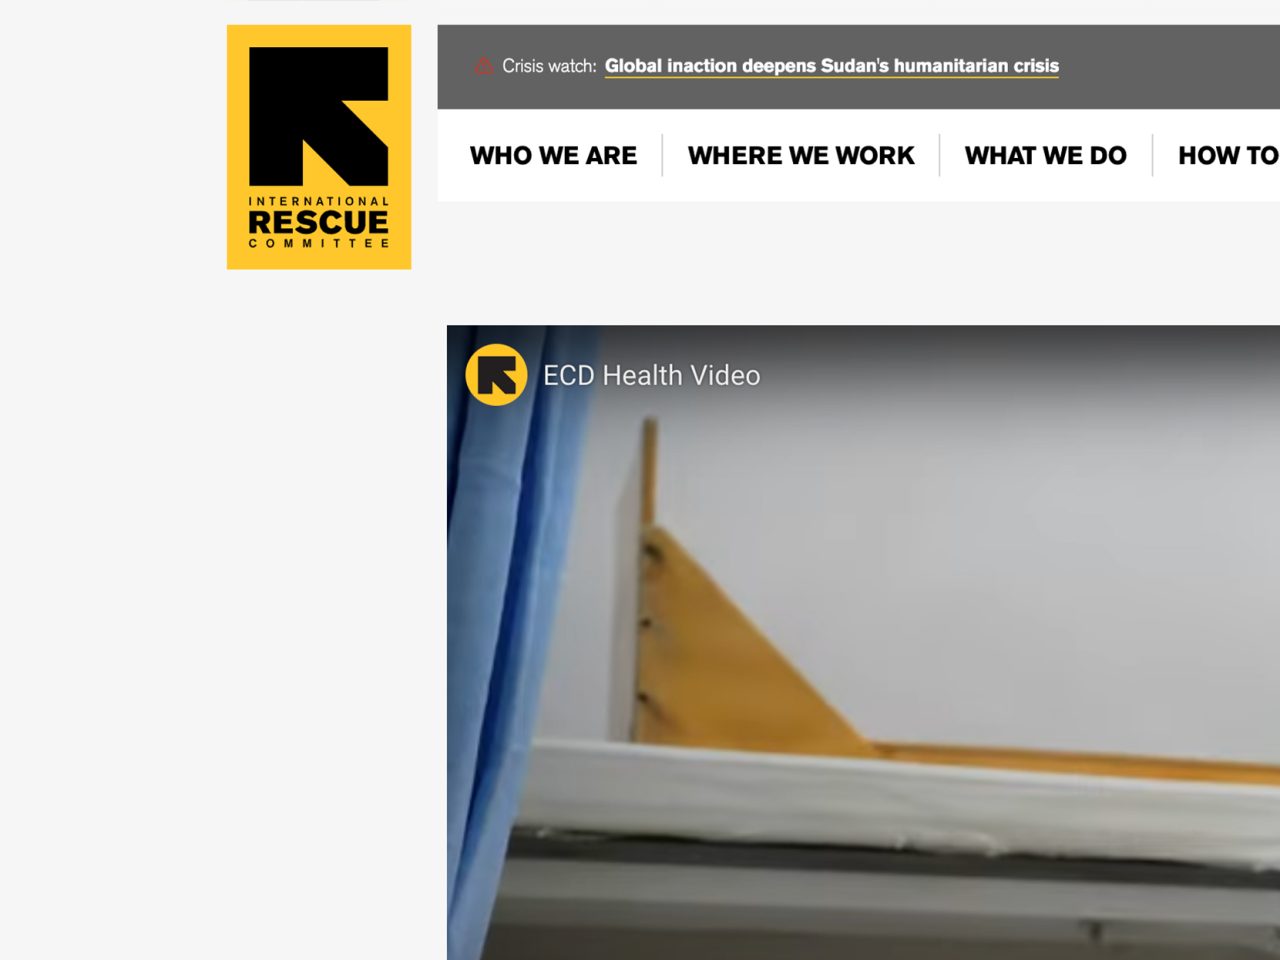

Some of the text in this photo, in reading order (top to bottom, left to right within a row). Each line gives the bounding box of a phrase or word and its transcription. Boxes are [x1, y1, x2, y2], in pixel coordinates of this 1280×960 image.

[503, 58, 1059, 77] Crisis watch: Global inaction deepens Sudan's humanitarian crisis
[470, 145, 637, 165] WHO WE ARE
[688, 145, 915, 165] WHERE WE WORK
[965, 145, 1127, 165] WHAT WE DO
[1179, 145, 1240, 165] HOW
[1246, 145, 1279, 165] TO
[248, 196, 389, 206] INTERNATIONAL
[248, 210, 389, 235] RESCUE
[248, 238, 389, 249] COMMITTEE
[544, 364, 760, 386] ECD Health Video
